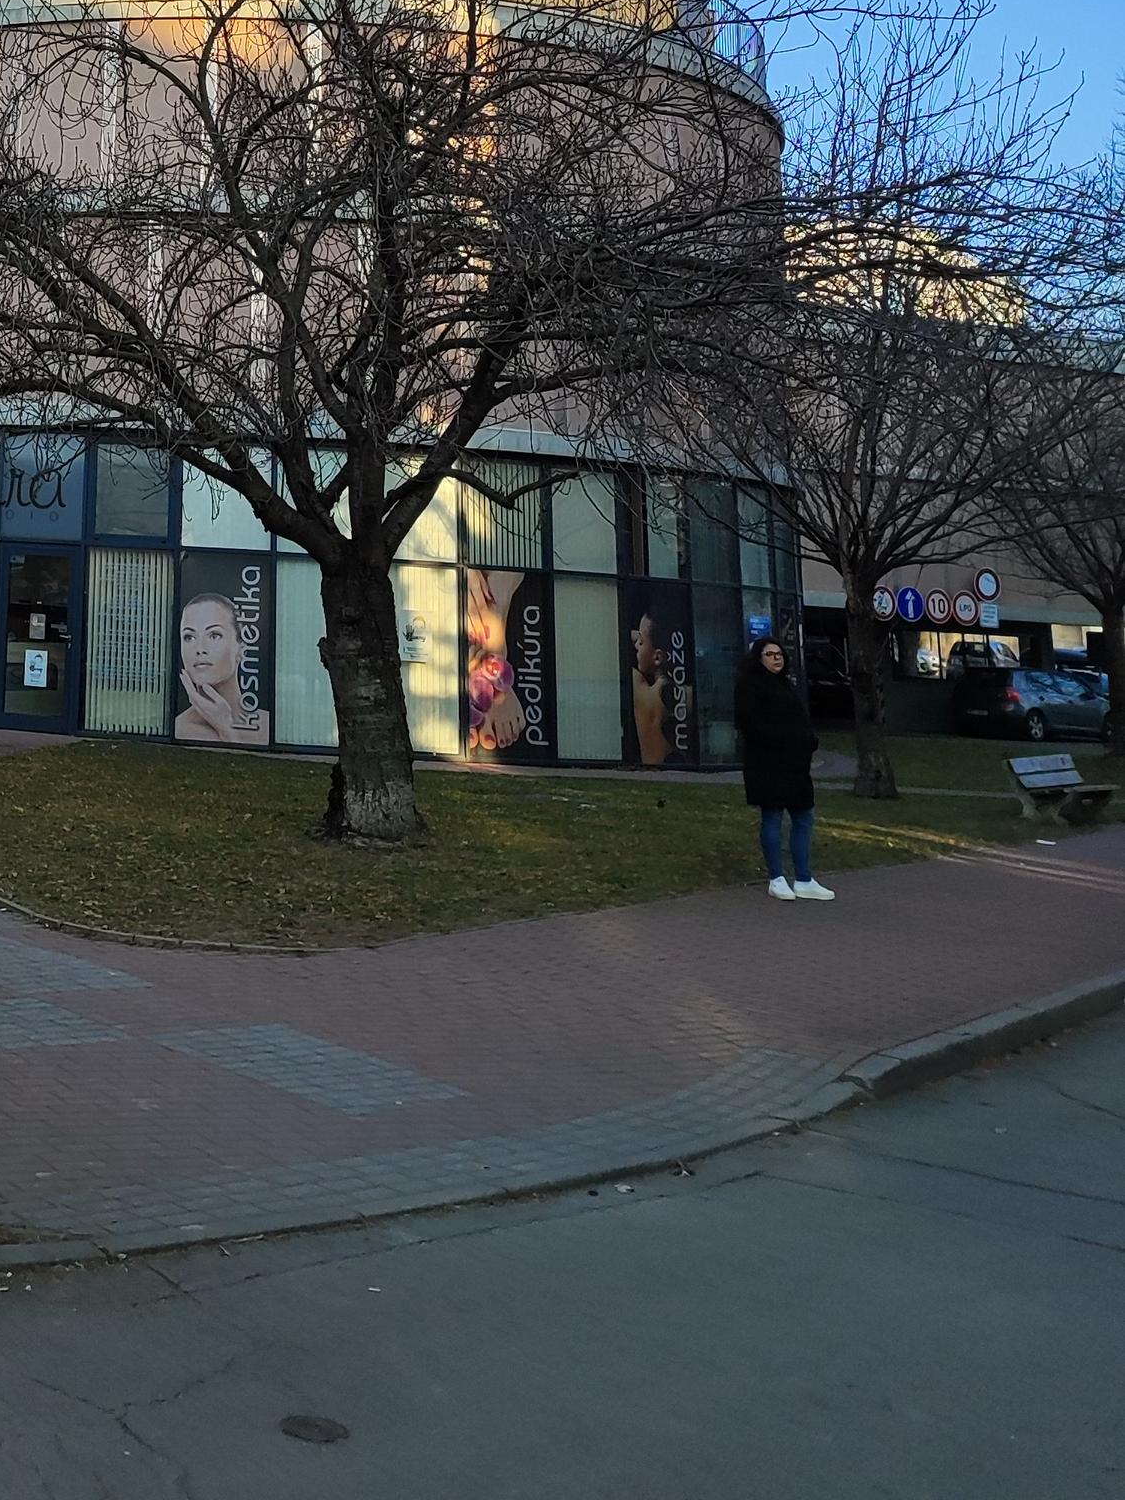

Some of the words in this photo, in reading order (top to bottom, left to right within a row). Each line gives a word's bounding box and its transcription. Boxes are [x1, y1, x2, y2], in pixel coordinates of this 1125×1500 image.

[231, 565, 261, 731] kosmetika
[930, 598, 945, 614] 10
[517, 605, 549, 746] pedikúra
[667, 631, 688, 750] masáže
